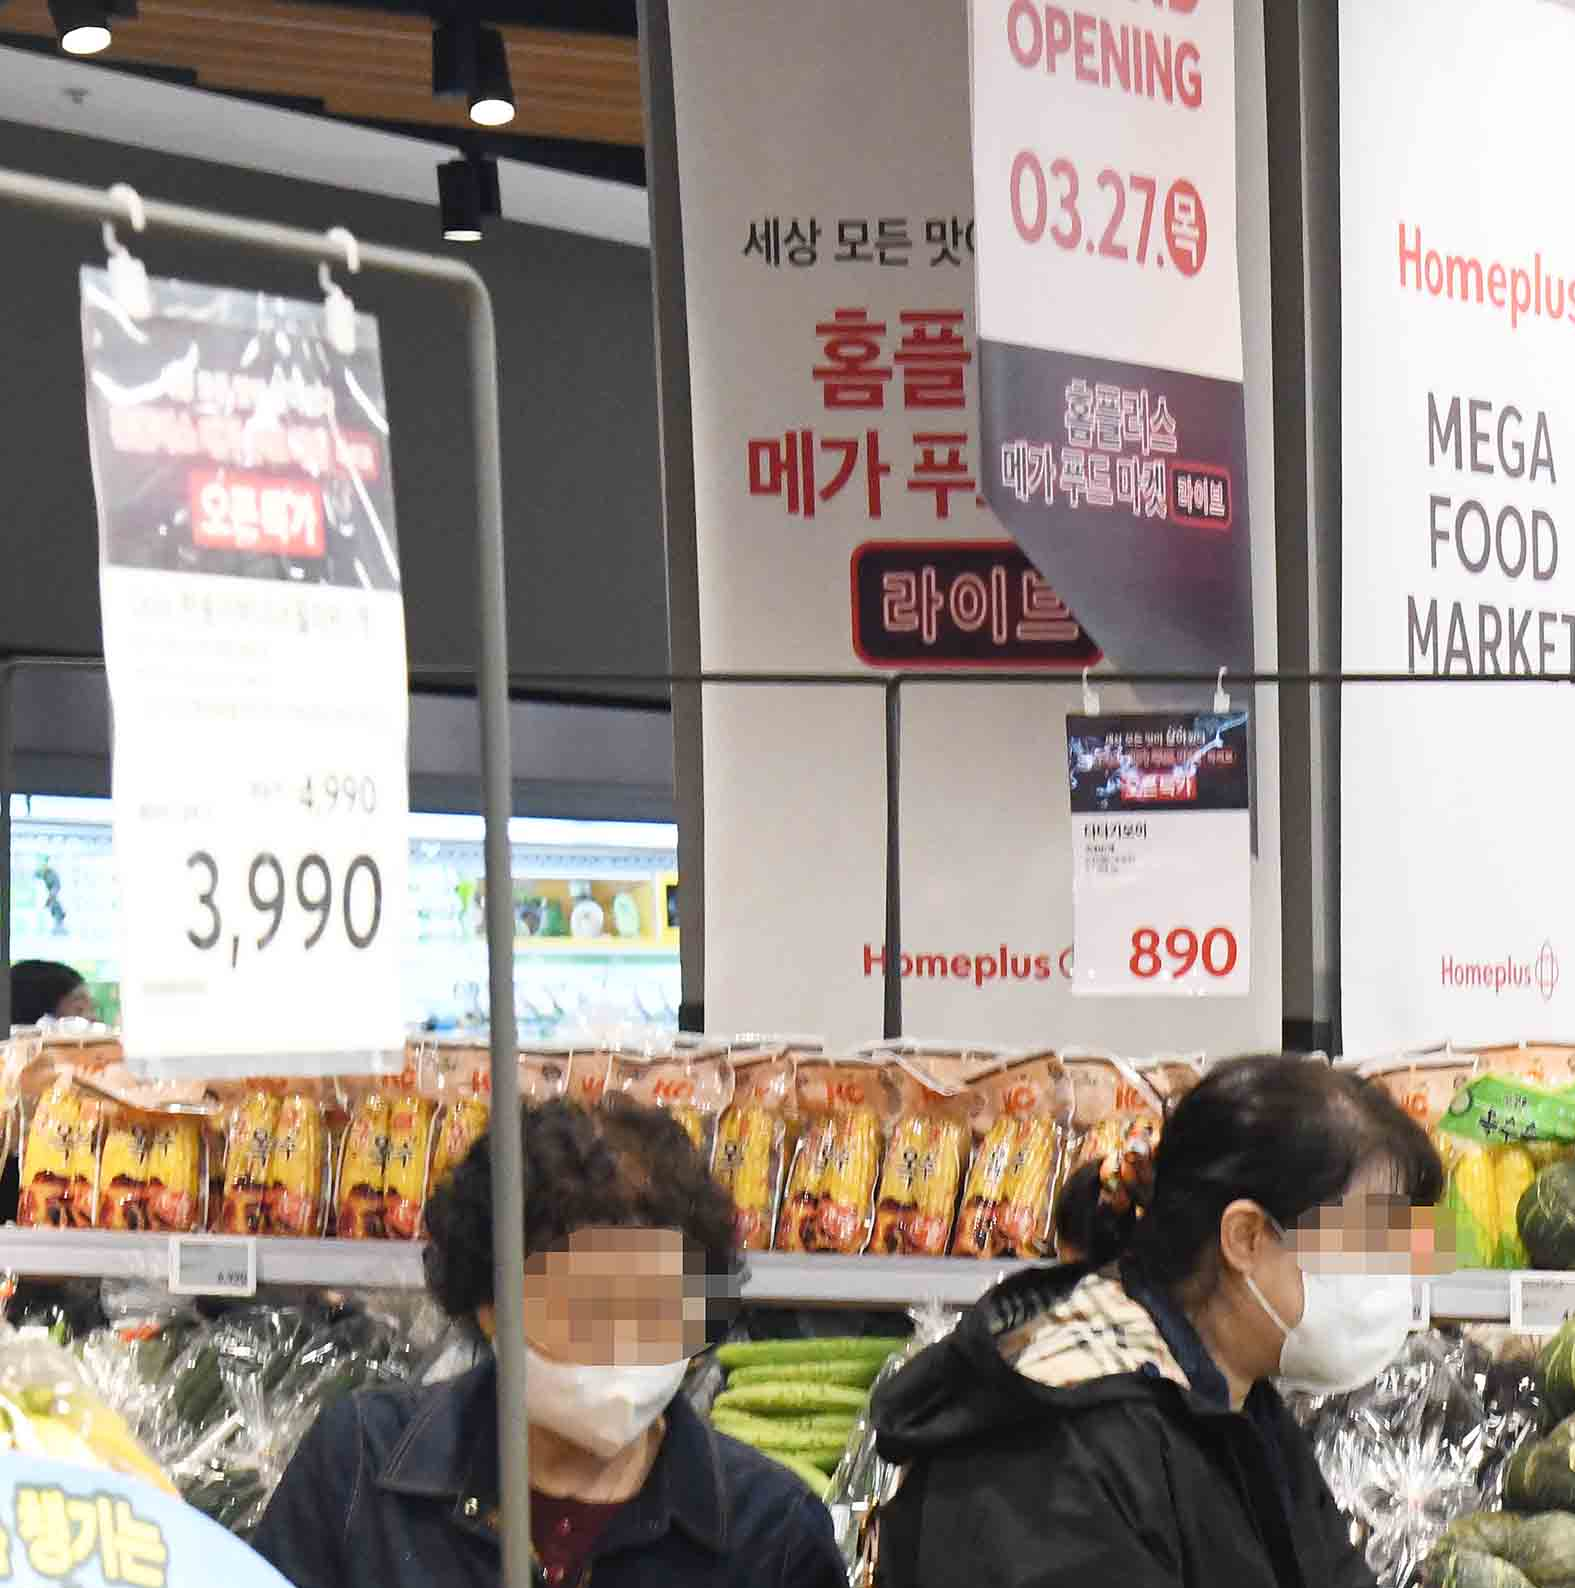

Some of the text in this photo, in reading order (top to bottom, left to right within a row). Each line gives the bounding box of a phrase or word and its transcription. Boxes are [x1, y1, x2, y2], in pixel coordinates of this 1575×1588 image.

[1007, 0, 1202, 109] OPENING
[743, 217, 822, 267] 세상
[833, 217, 913, 267] 모든
[1064, 376, 1178, 456] 홈플러스
[1426, 390, 1557, 486] MEGA
[747, 430, 984, 519] 메가 푸
[1000, 441, 1226, 519] 메가 푸드 마켓 라이브
[1427, 494, 1559, 582] FOOD
[881, 564, 1079, 644] 라이브
[186, 850, 382, 969] 3,990
[862, 943, 1051, 986] Homeplus
[1129, 927, 1238, 979] 890
[1441, 952, 1533, 993] Homeplus
